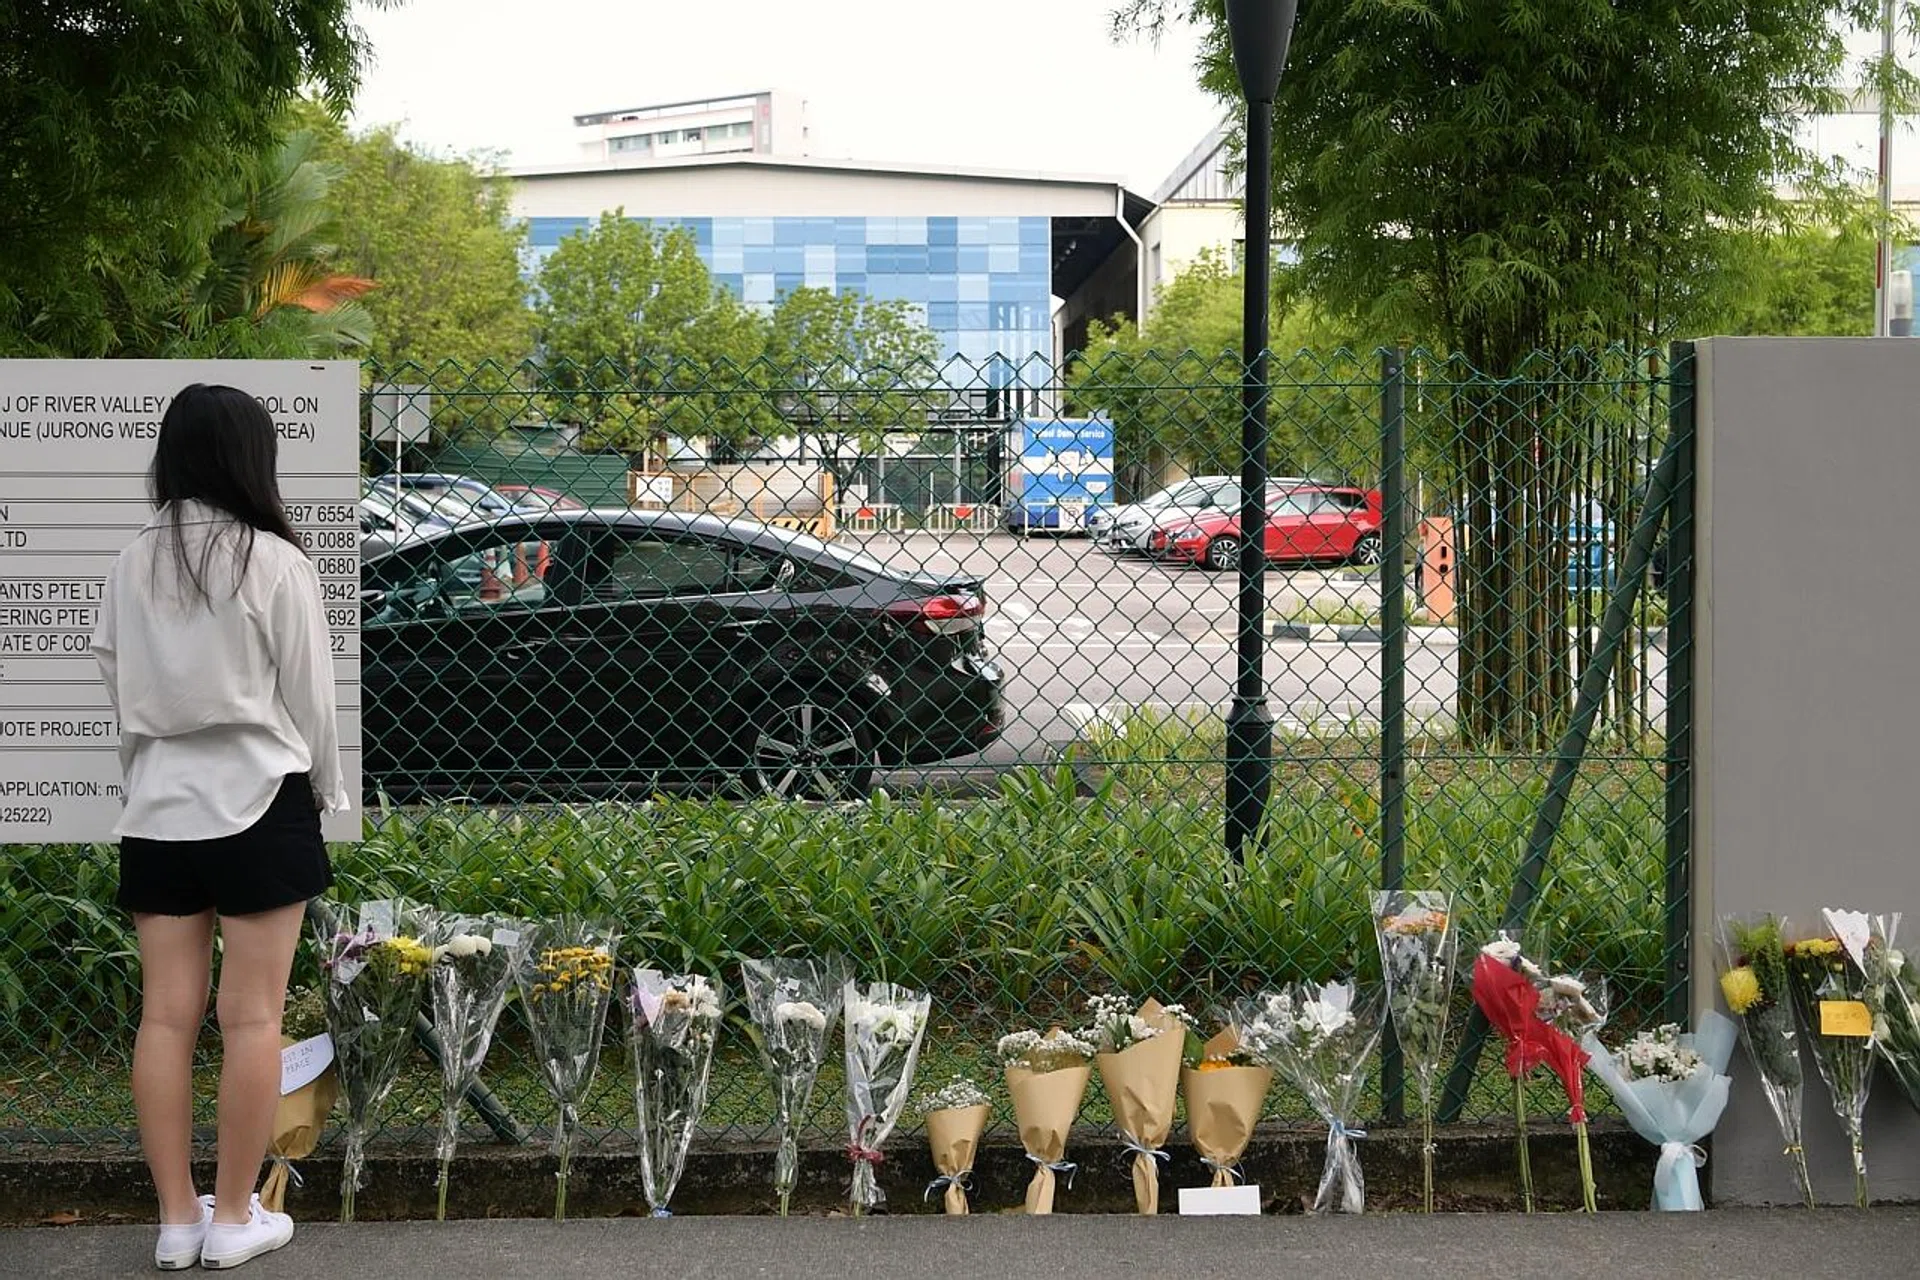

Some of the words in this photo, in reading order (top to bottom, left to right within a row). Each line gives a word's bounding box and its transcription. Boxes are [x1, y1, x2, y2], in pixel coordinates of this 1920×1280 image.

[16, 396, 40, 413] OF
[44, 396, 97, 413] RIVER
[100, 396, 166, 413] VALLEY
[293, 396, 318, 413] ON
[36, 421, 114, 442] (JURONG
[317, 506, 355, 522] 6554
[317, 532, 355, 548] 0088
[317, 558, 356, 574] 0680
[0, 583, 43, 599] ANTS
[48, 583, 81, 599] PTE
[57, 609, 89, 625] PTE
[37, 634, 58, 651] OF
[40, 721, 112, 736] PROJECT
